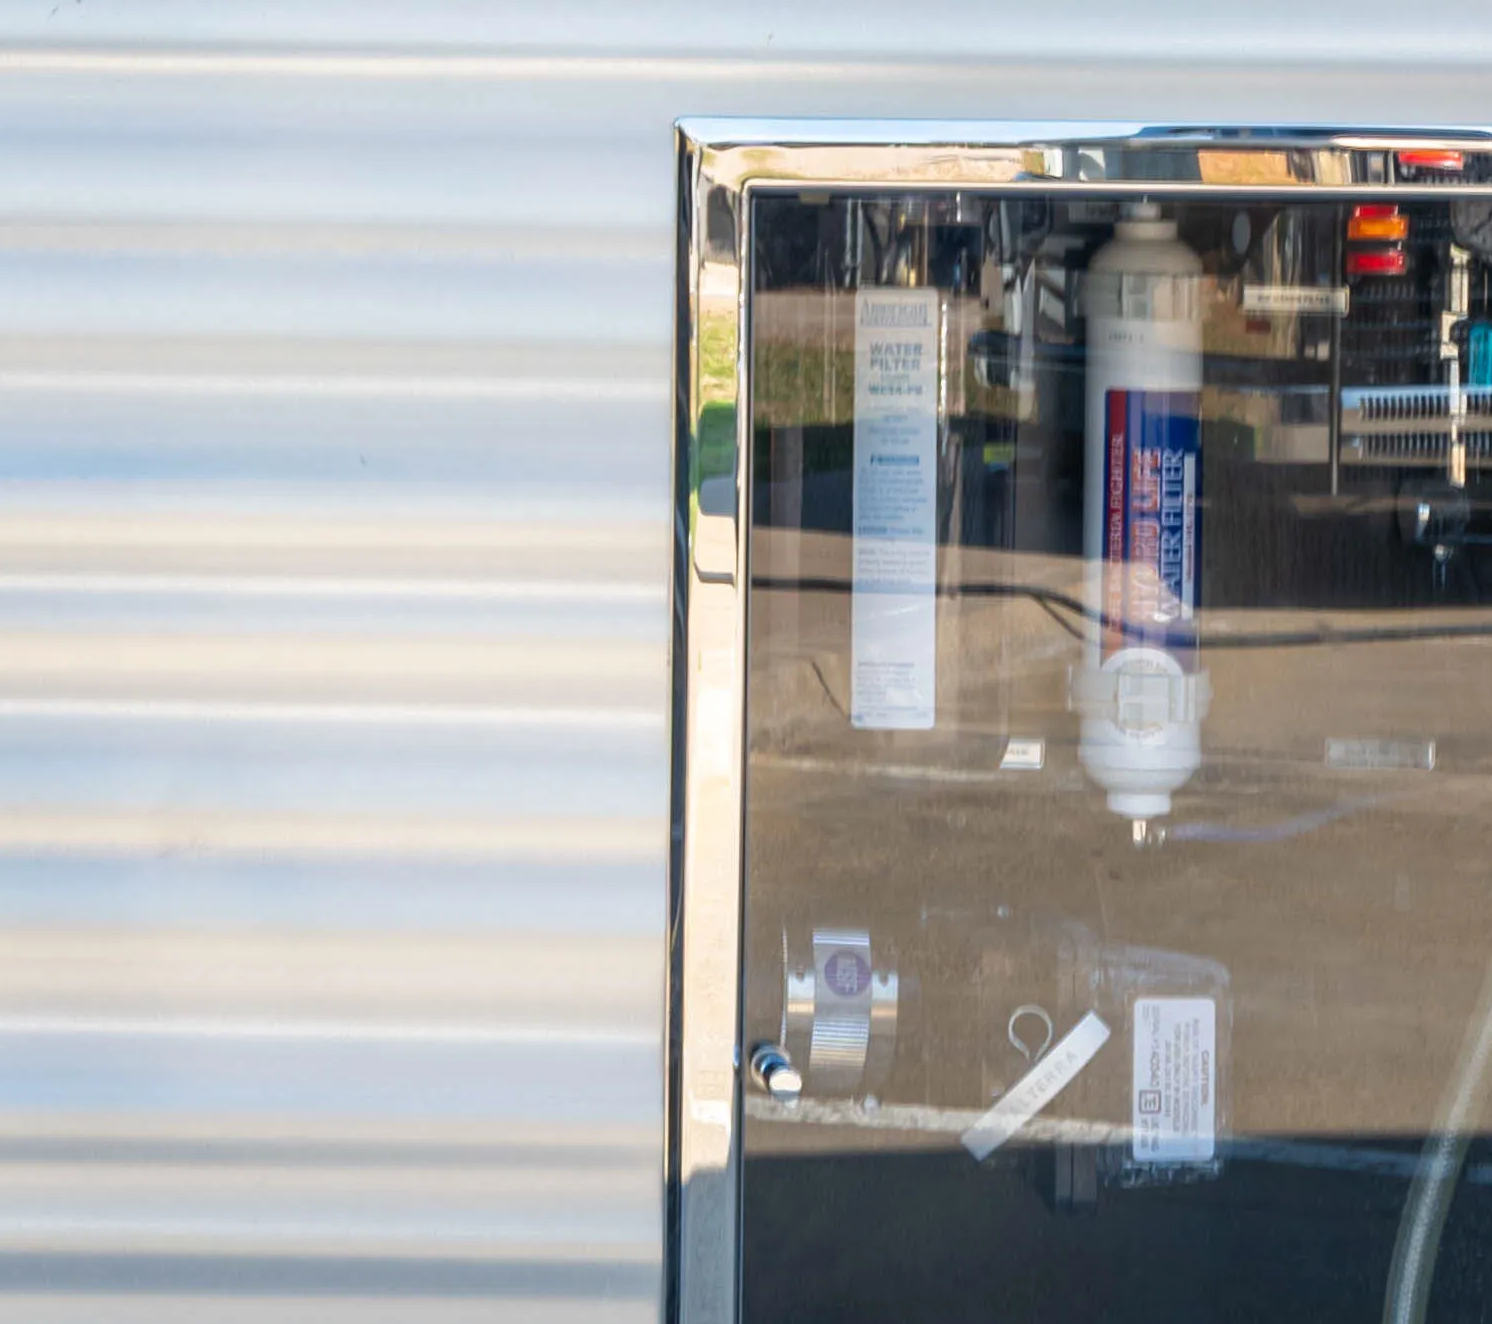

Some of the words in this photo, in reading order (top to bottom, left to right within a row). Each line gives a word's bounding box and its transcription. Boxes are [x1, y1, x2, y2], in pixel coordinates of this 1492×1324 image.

[870, 343, 923, 356] WATER
[1131, 447, 1160, 513] LIFE
[1161, 448, 1184, 526] FILTER
